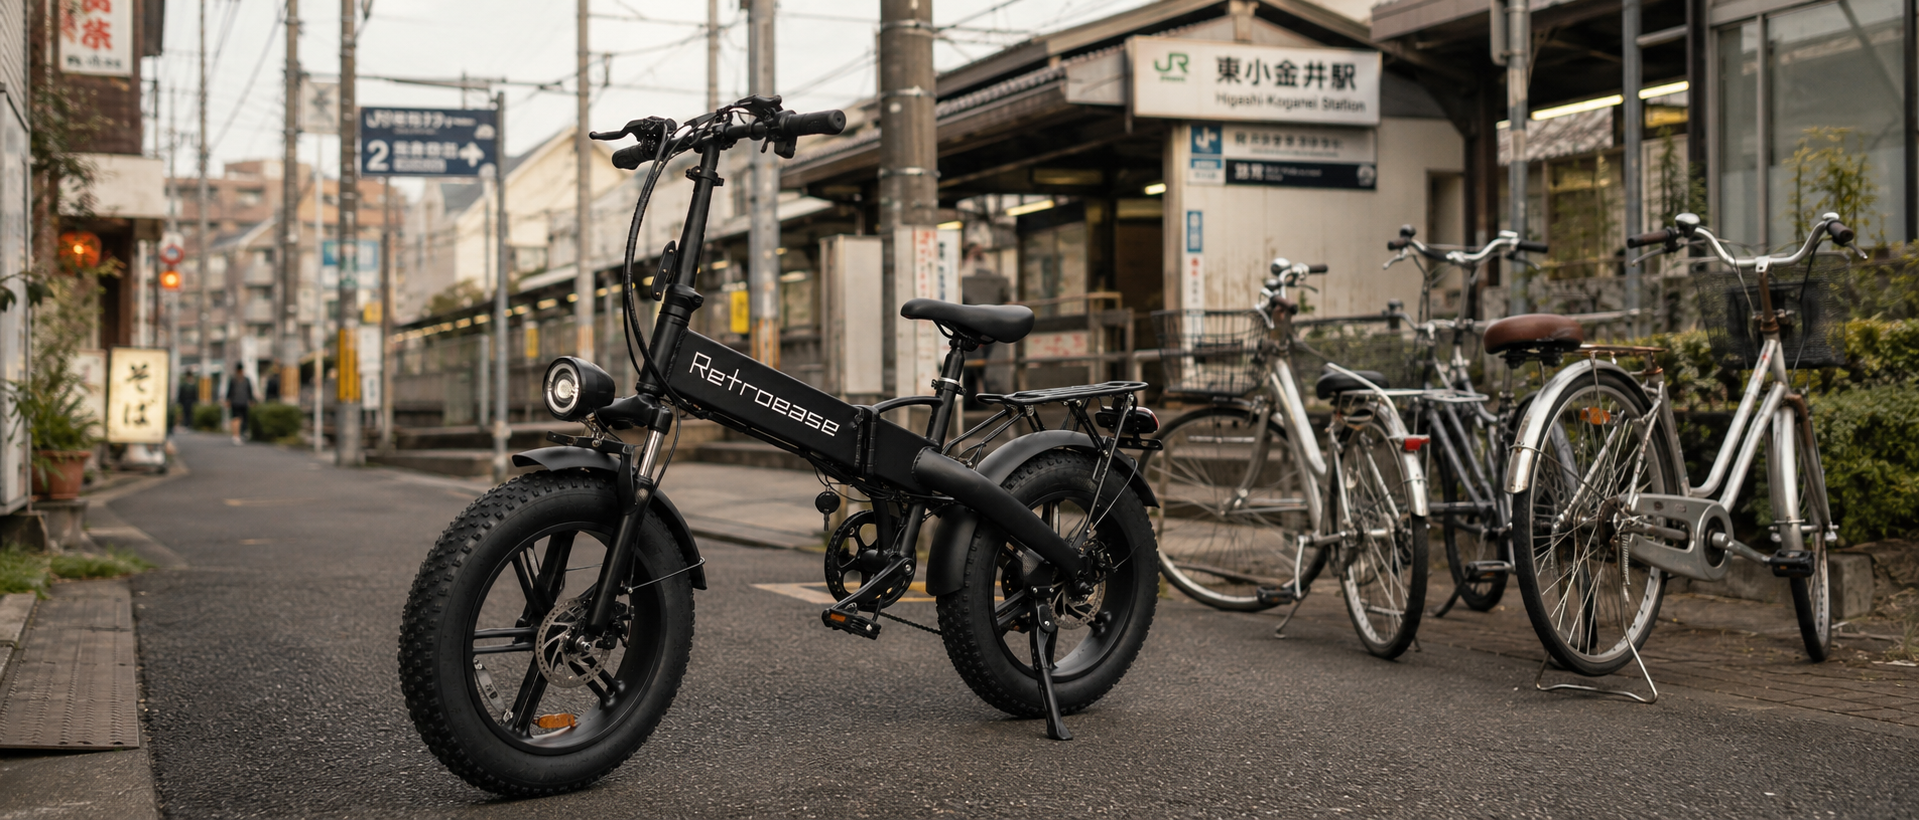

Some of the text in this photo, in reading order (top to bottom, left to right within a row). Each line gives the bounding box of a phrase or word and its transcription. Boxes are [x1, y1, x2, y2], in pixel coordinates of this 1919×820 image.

[1154, 52, 1188, 73] JR
[1216, 57, 1357, 90] 東小金井駅
[366, 139, 389, 172] 2
[689, 351, 840, 437] Retroease
